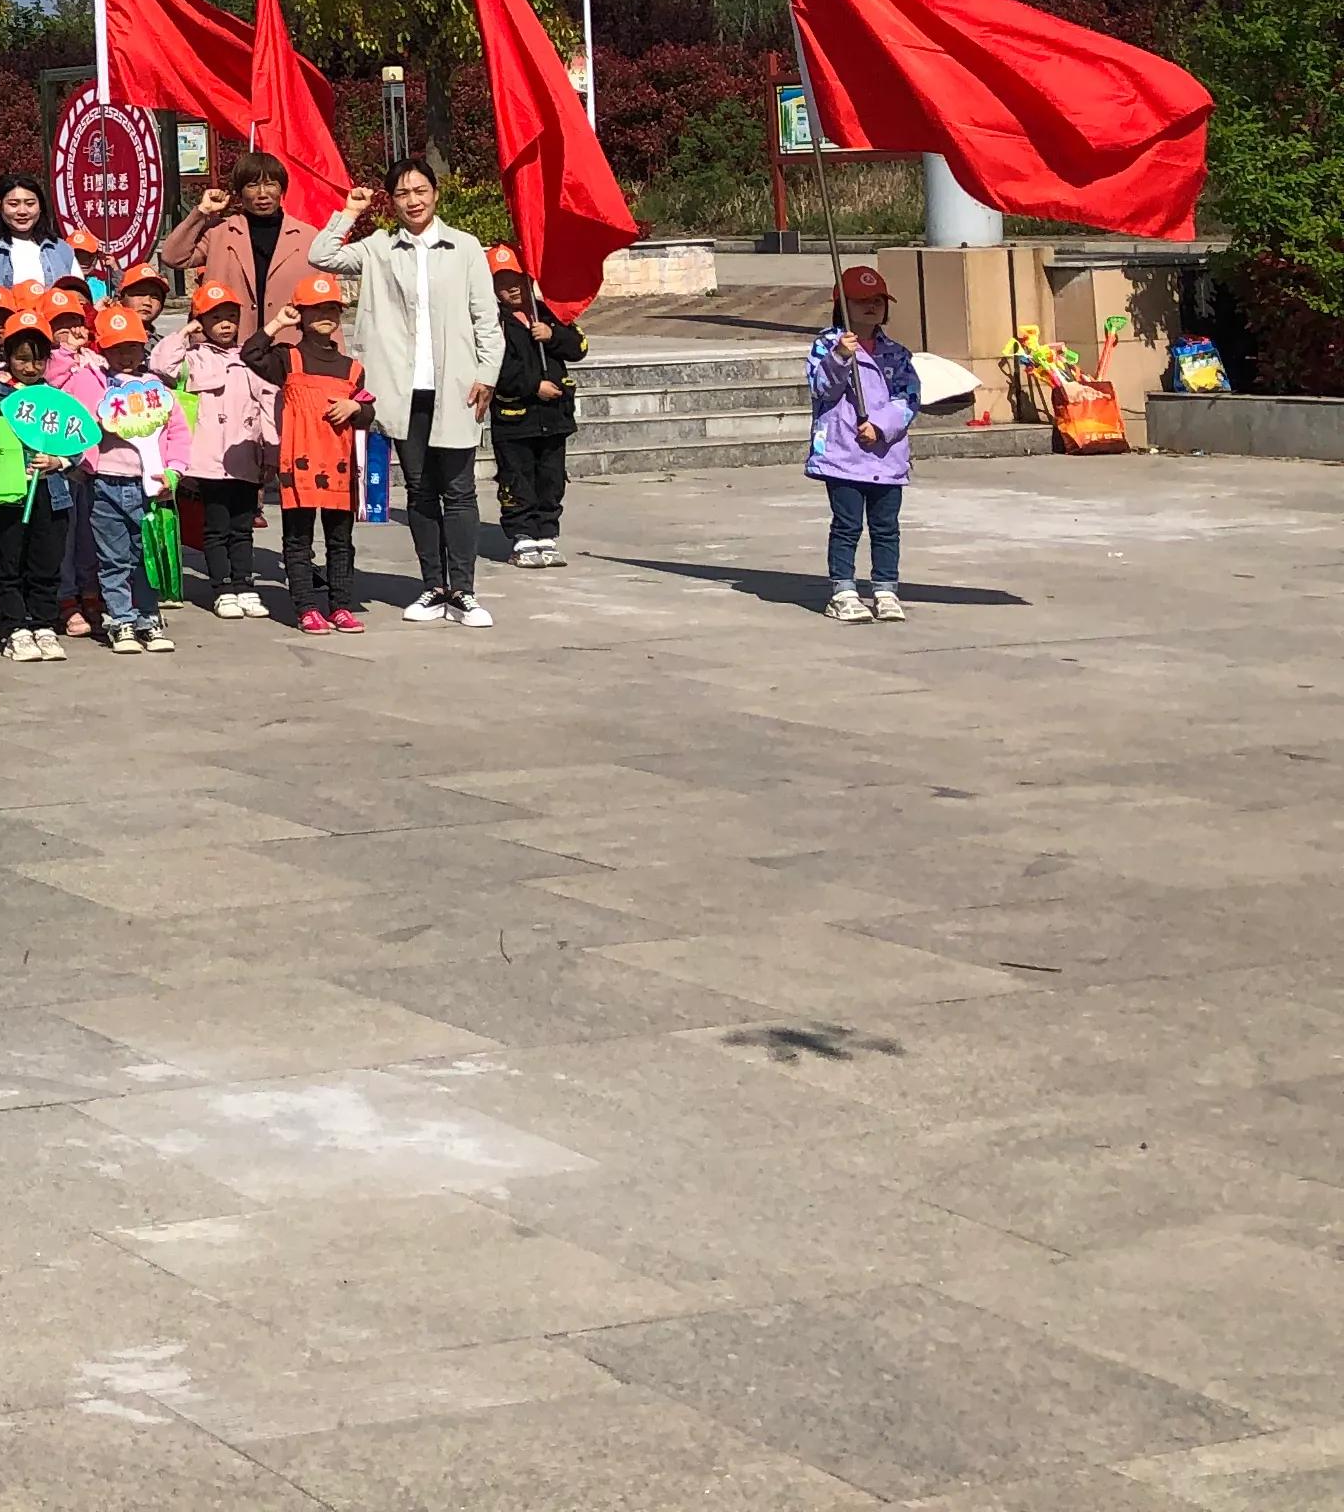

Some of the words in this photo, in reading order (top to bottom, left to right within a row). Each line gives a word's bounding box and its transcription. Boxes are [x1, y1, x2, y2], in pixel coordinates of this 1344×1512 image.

[84, 199, 129, 217] 平安家园
[15, 400, 87, 444] 环保队
